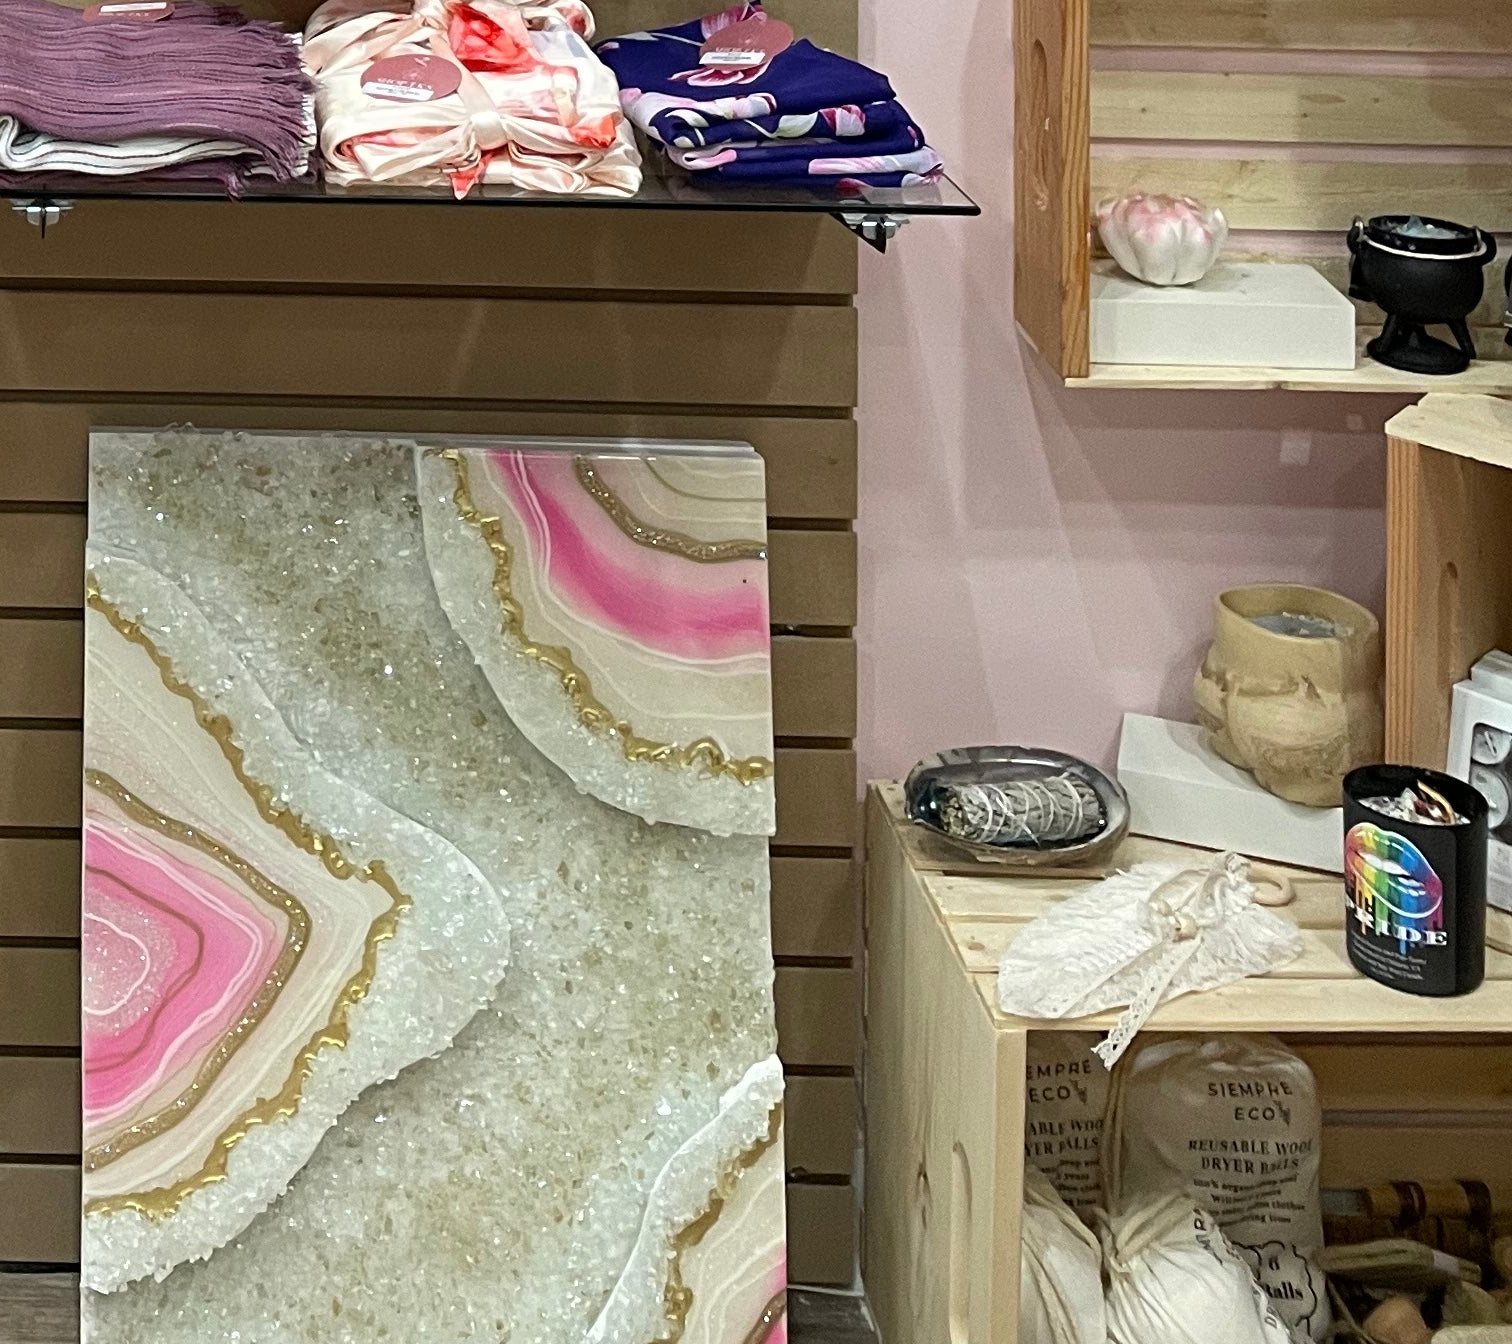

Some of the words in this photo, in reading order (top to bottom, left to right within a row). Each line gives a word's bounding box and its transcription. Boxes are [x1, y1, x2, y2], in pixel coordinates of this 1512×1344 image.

[1026, 1059, 1092, 1081] EMPRE
[1028, 1085, 1071, 1103] ECO
[1207, 1080, 1293, 1098] SIEMPRE
[1234, 1106, 1276, 1121] ECO
[1188, 1138, 1270, 1155] REUSABLE
[1201, 1156, 1255, 1174] DRYER
